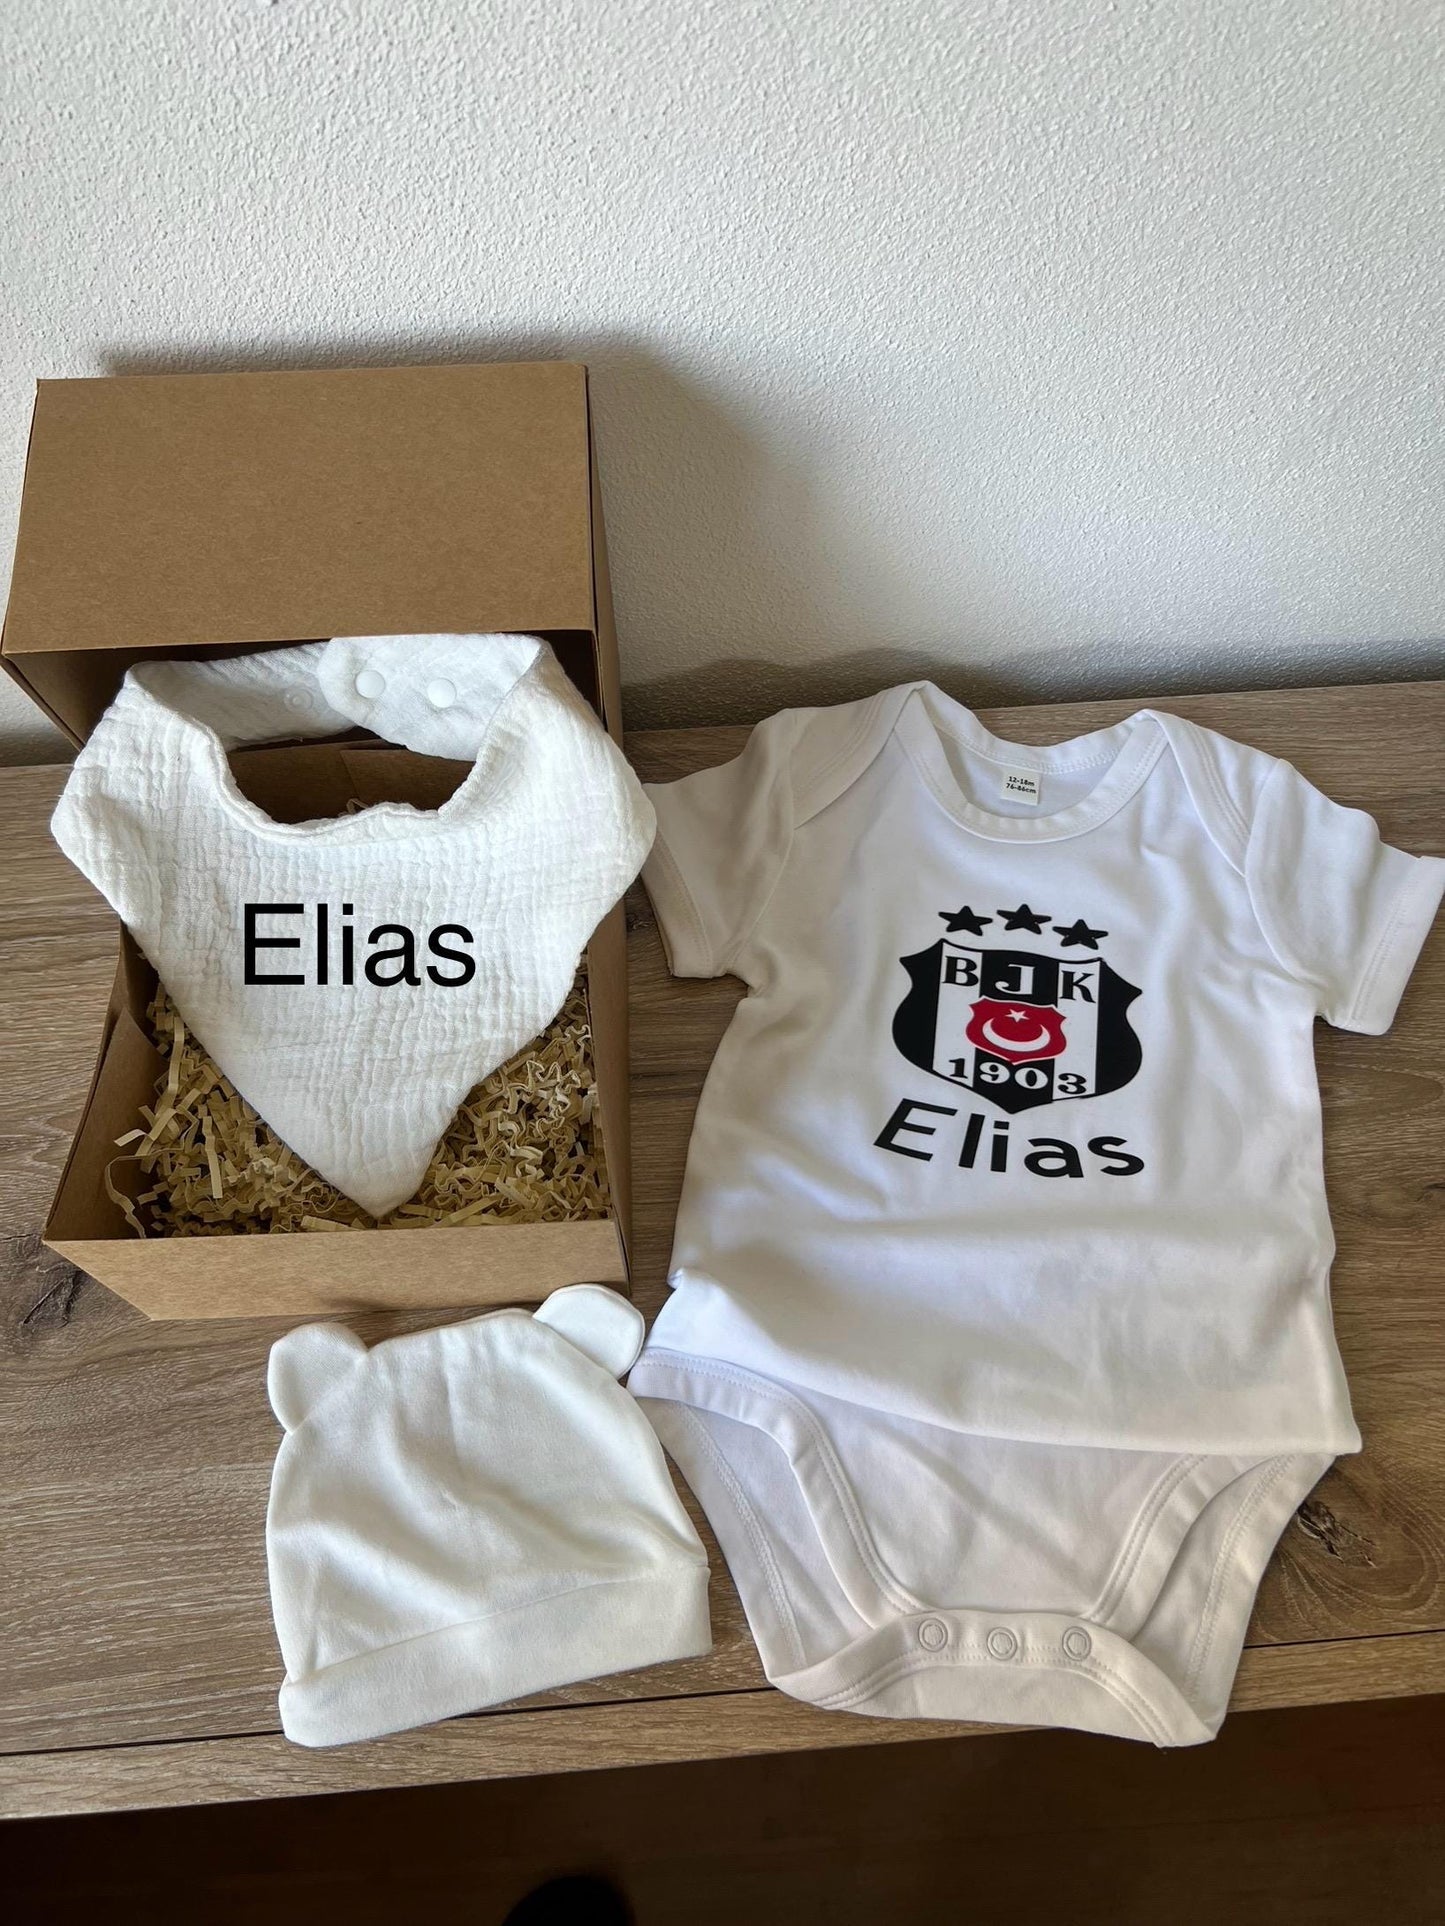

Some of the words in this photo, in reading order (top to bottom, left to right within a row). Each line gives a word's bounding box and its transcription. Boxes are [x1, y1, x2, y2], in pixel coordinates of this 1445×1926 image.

[1006, 782, 1036, 794] 76-86cm
[1008, 776, 1035, 786] 12-18m
[942, 956, 1096, 1003] BJK
[948, 1058, 1087, 1095] 1903
[873, 1098, 1145, 1178] Elias
